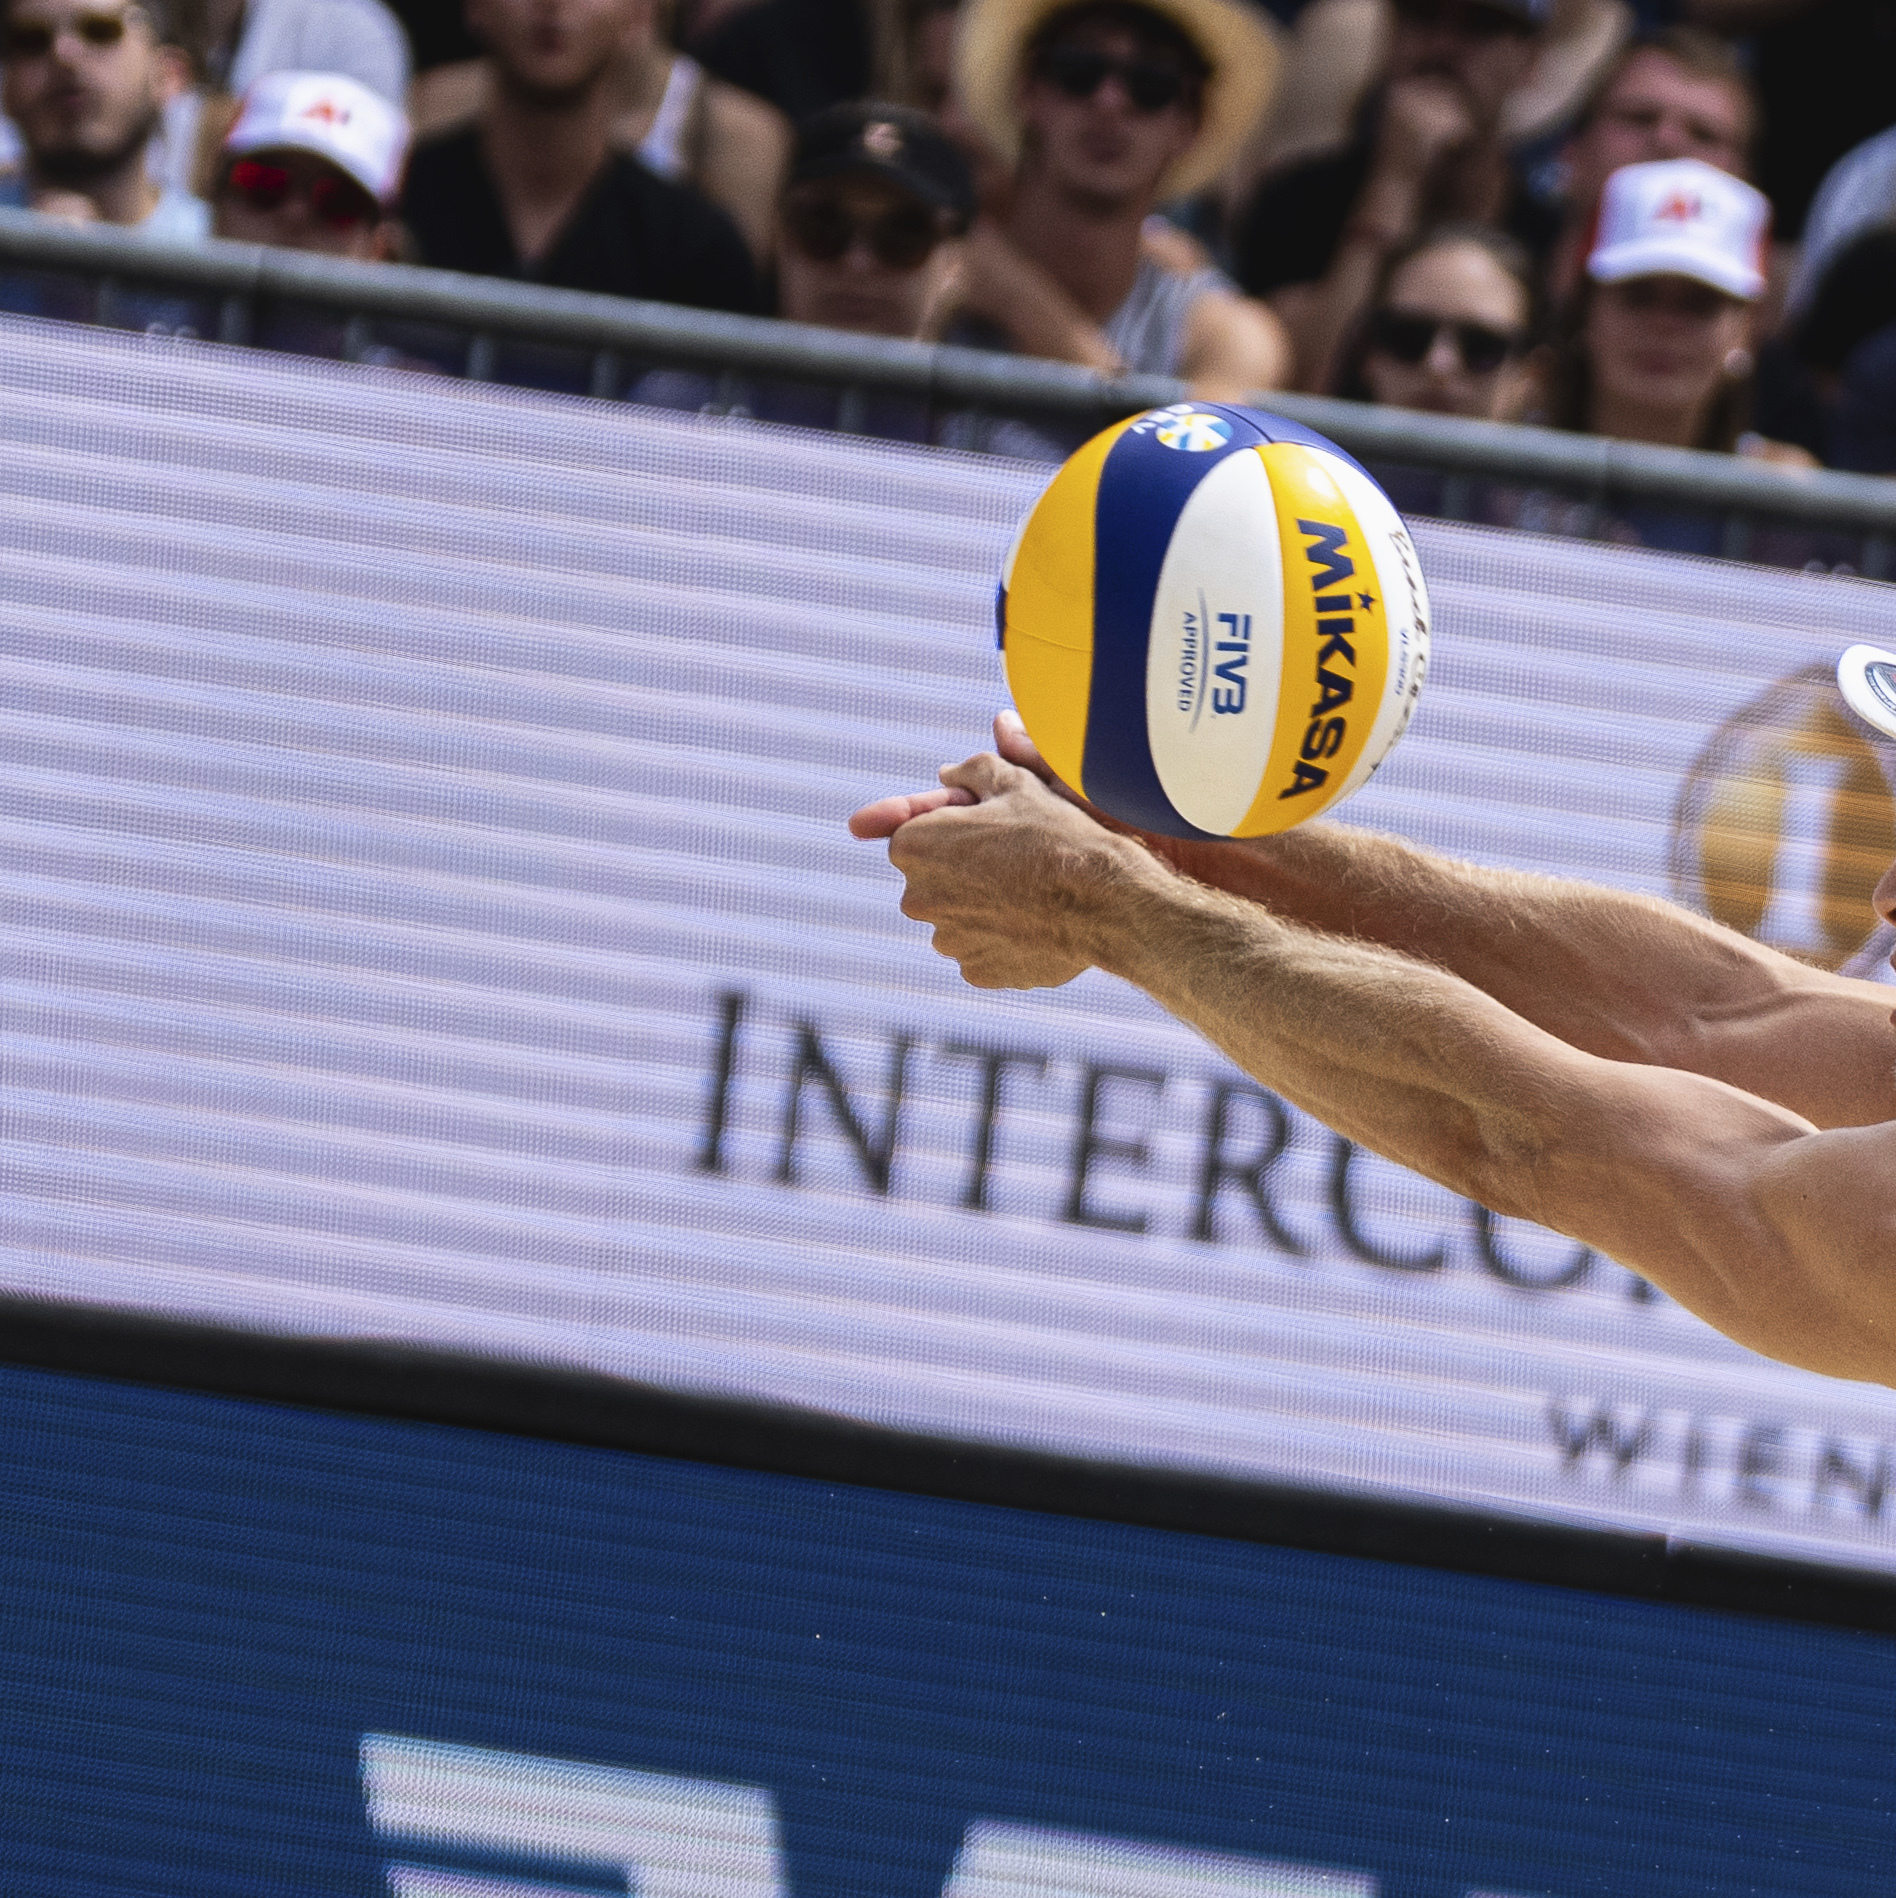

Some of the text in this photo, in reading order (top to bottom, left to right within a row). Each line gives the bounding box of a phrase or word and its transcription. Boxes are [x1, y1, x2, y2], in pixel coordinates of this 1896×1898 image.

[1177, 611, 1198, 713] APPROVED
[1211, 611, 1252, 715] FIVB
[1547, 1400, 1892, 1518] WIEN
